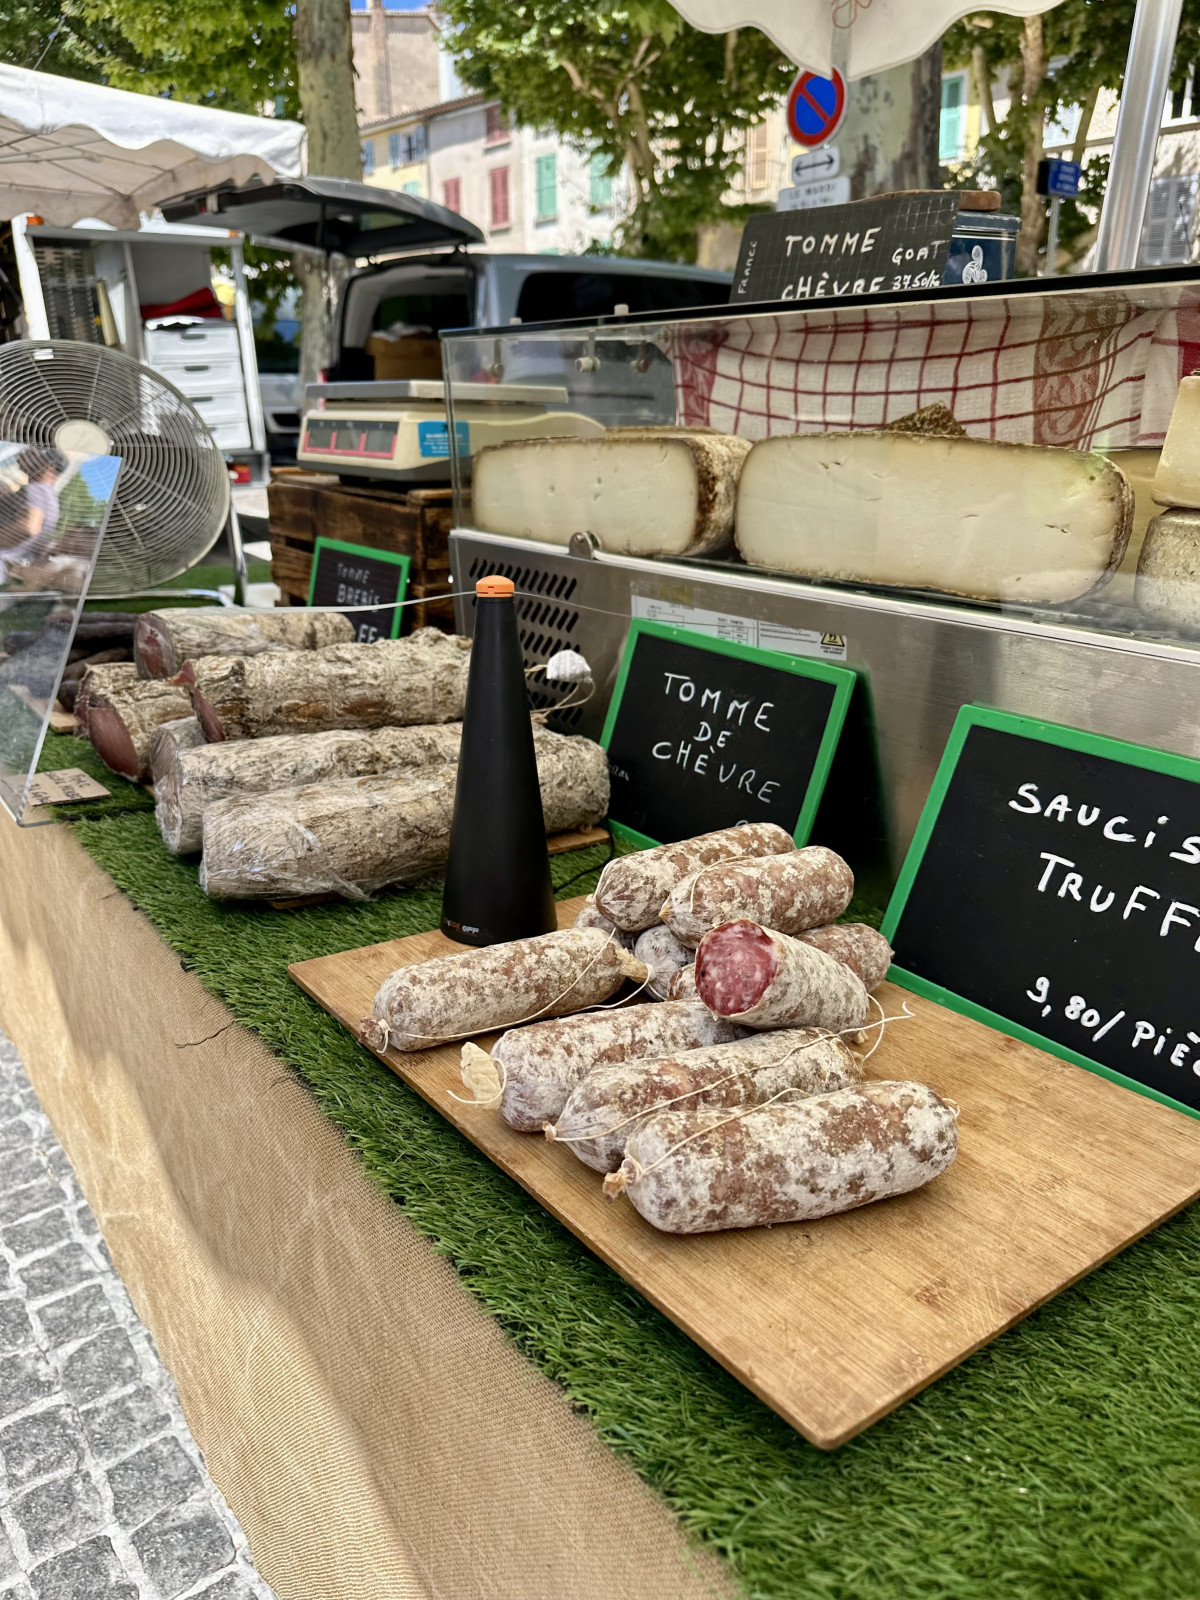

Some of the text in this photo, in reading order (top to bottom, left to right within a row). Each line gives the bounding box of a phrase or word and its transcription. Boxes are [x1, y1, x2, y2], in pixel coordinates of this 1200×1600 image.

[785, 226, 882, 257] TOMME
[891, 239, 948, 265] GOAT
[781, 271, 886, 300] CHÈVRE
[664, 672, 775, 732] TOMME
[693, 721, 733, 748] DE
[651, 740, 781, 804] CHÈVRE
